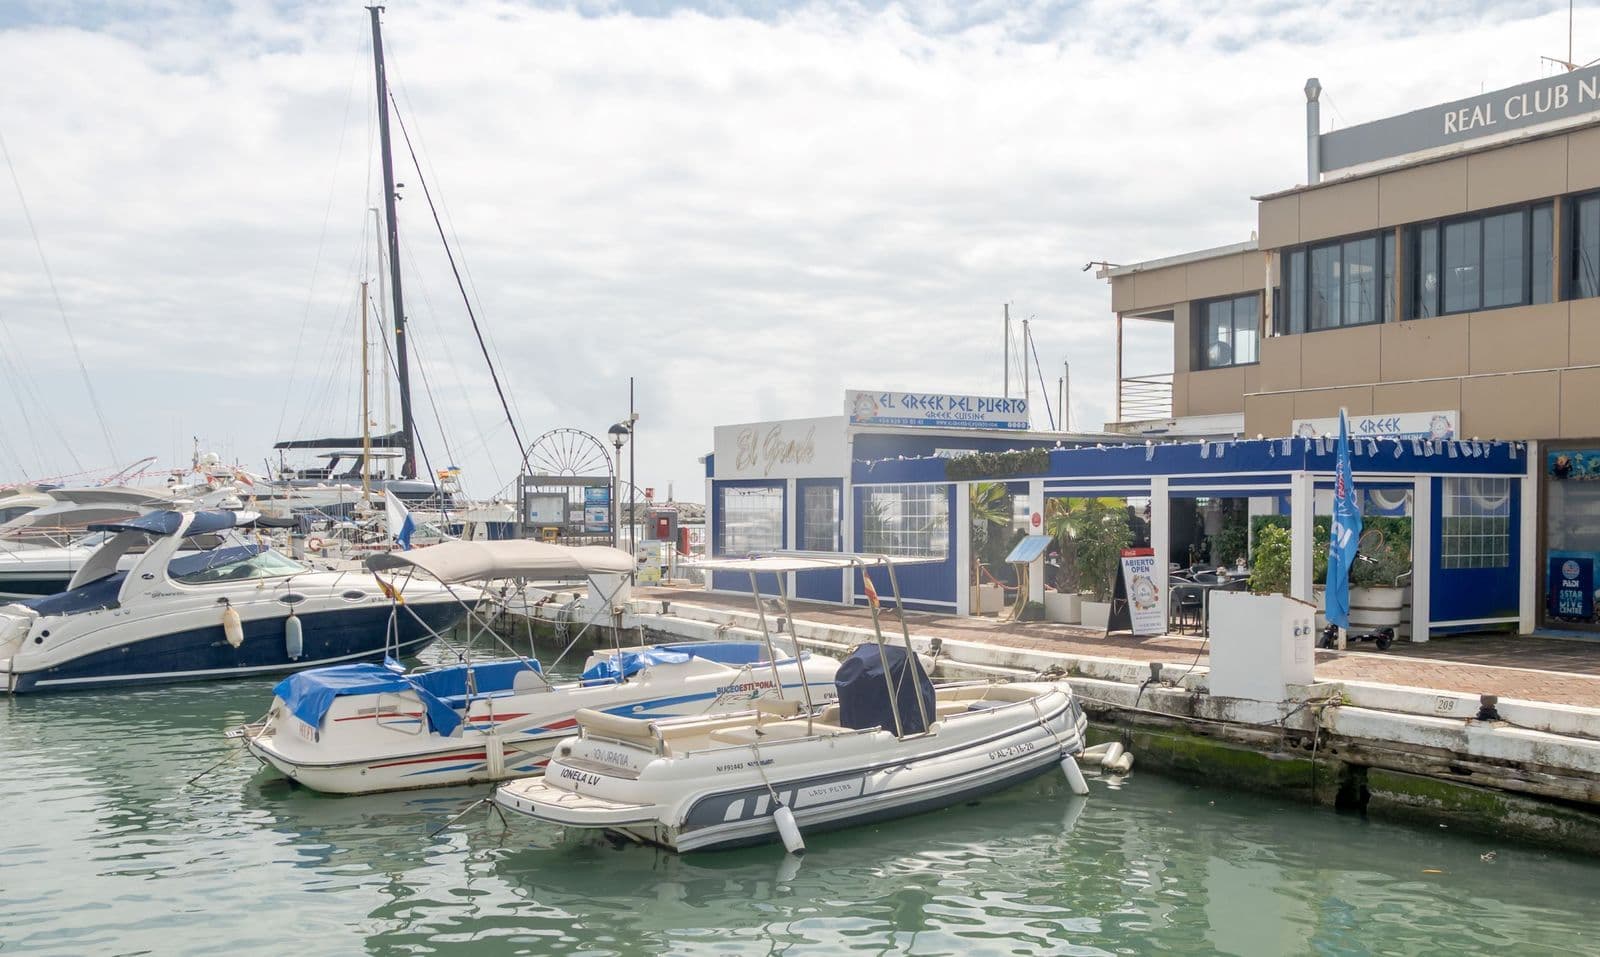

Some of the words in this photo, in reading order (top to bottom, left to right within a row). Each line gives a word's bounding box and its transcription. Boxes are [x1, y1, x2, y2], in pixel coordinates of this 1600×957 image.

[1444, 103, 1496, 134] REAL
[1504, 84, 1569, 120] CLUB
[1578, 76, 1600, 103] N
[880, 393, 895, 409] EL
[901, 394, 944, 411] GREEK
[949, 396, 973, 412] DEL
[977, 398, 1026, 414] PUERTO
[925, 410, 951, 419] GREEK
[954, 412, 985, 420] CUISINE
[1359, 418, 1401, 434] GREEK
[1125, 559, 1155, 567] ABIERTO
[1131, 566, 1150, 574] OPEN
[1562, 579, 1579, 588] PADI
[1437, 699, 1455, 711] 209
[560, 768, 588, 784] IONELA
[588, 775, 601, 786] LV
[808, 787, 829, 798] LADY
